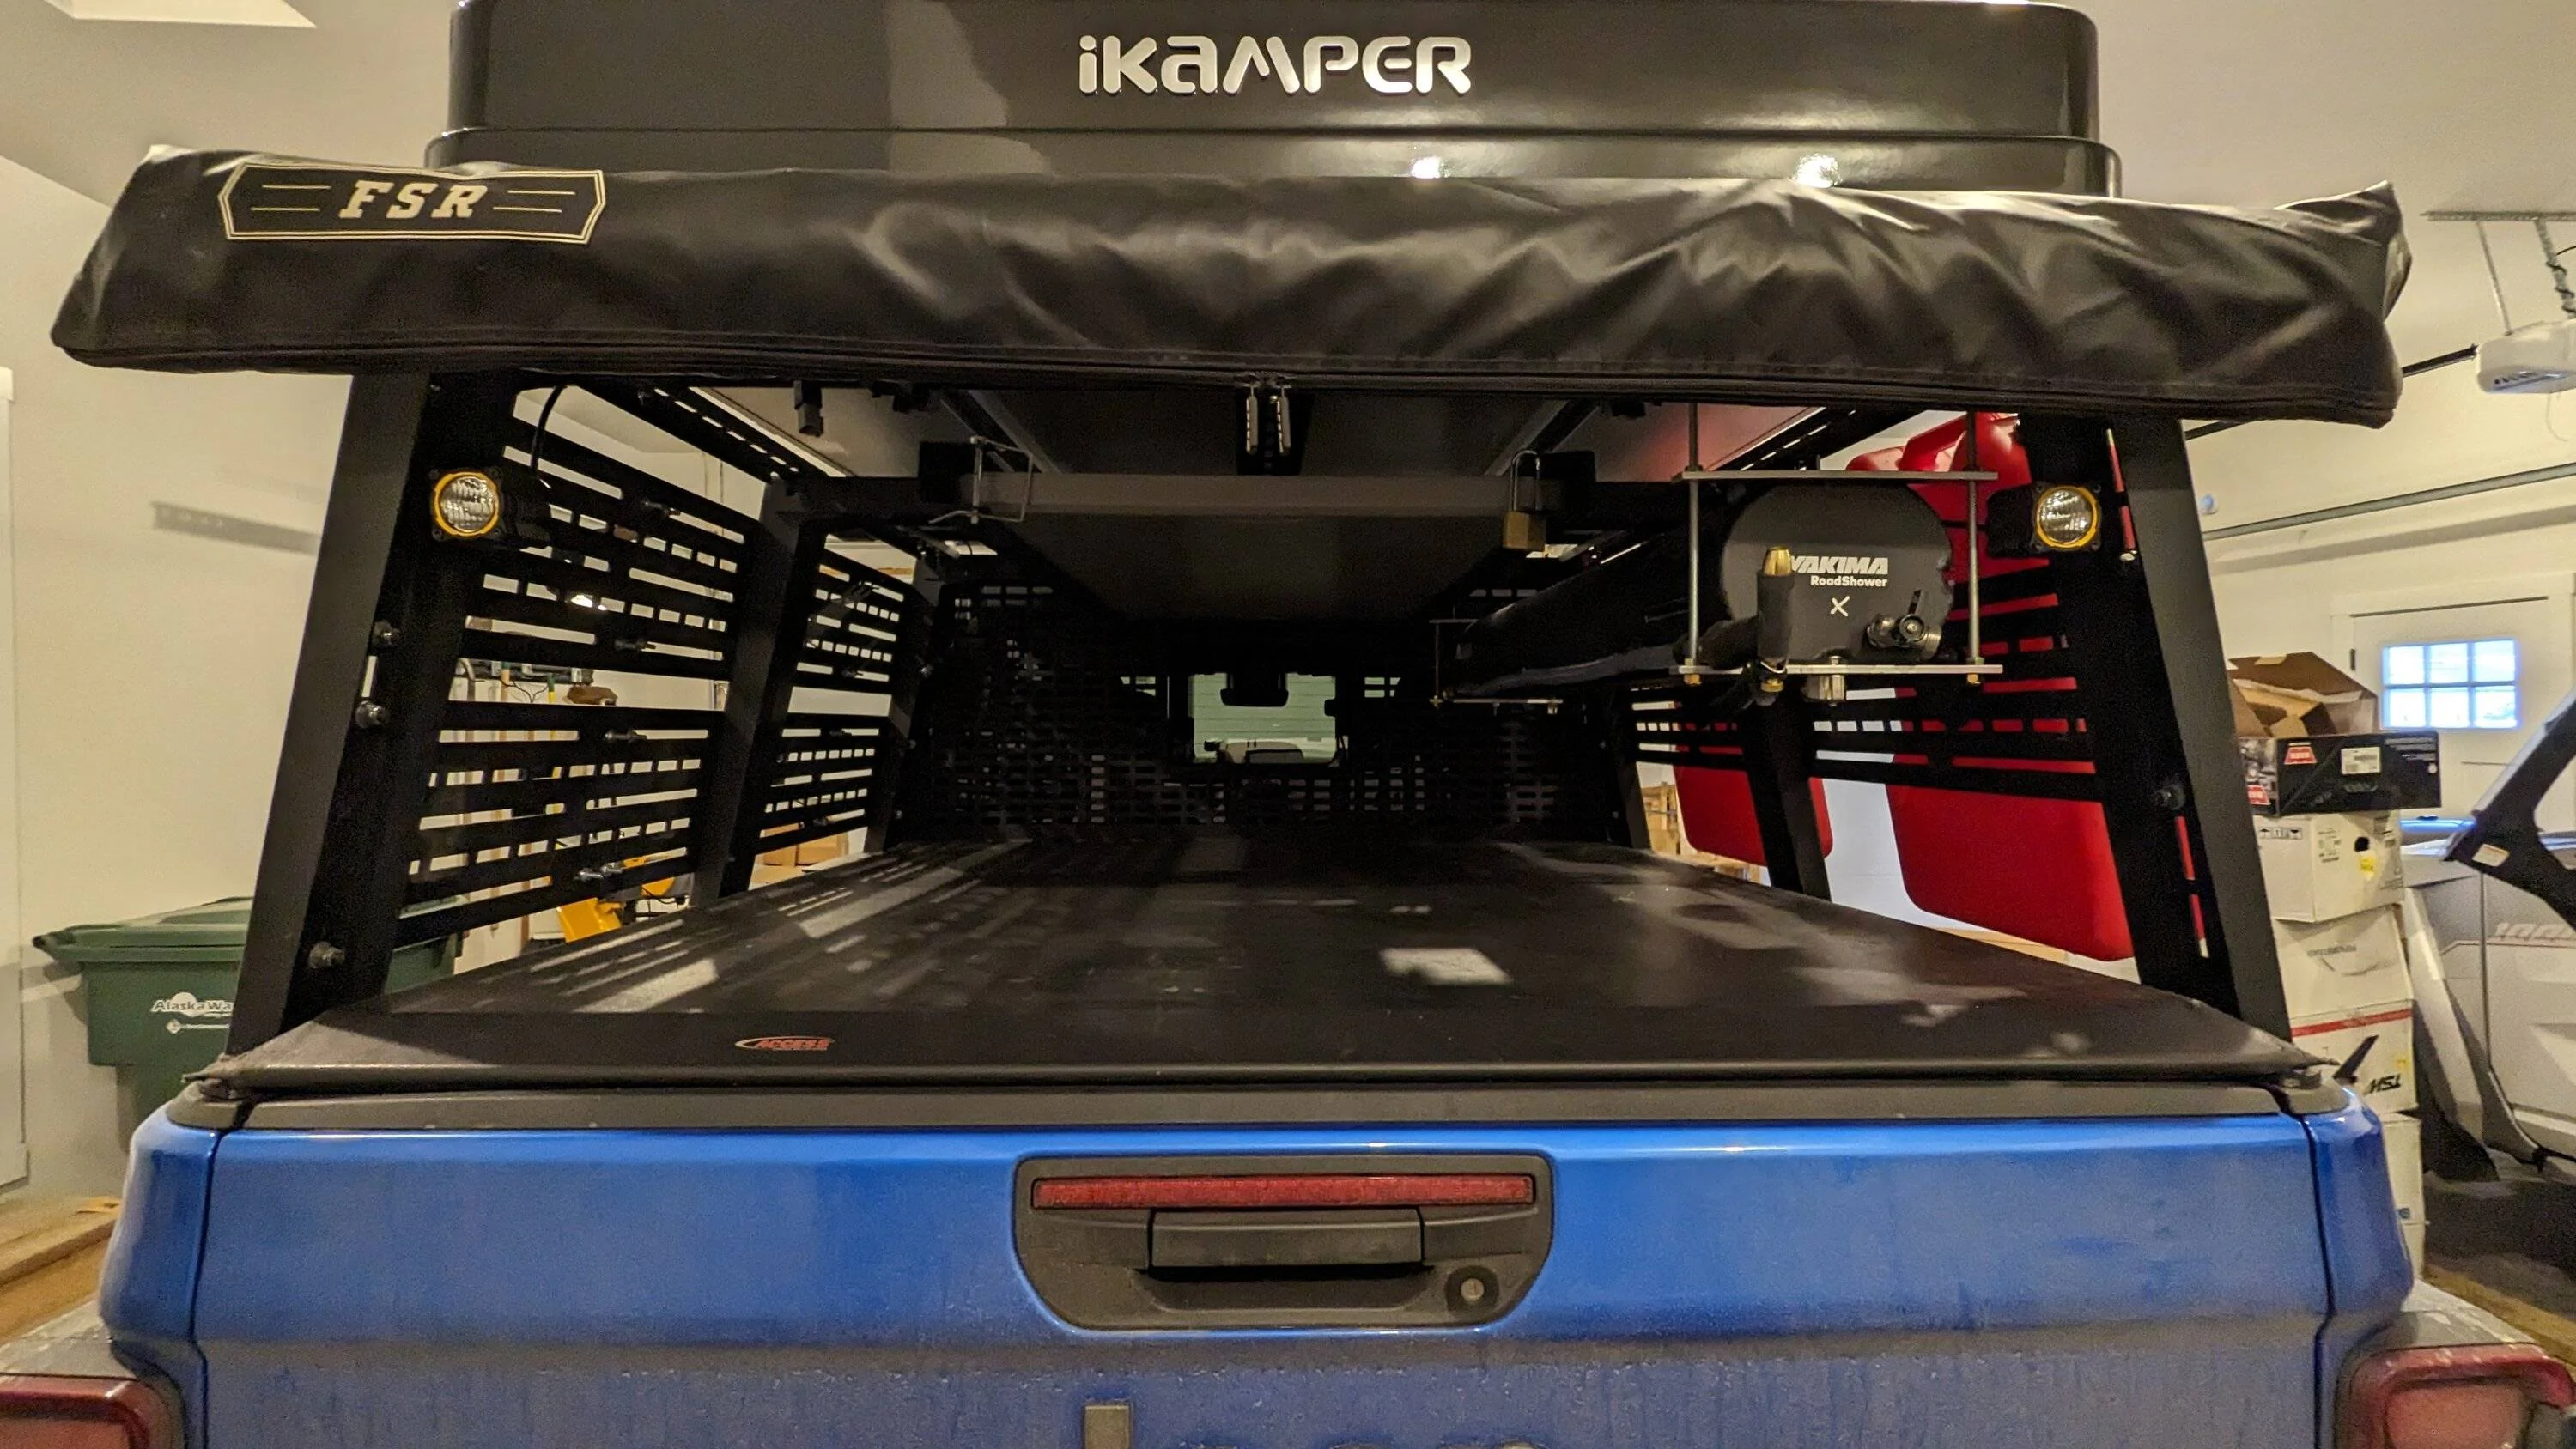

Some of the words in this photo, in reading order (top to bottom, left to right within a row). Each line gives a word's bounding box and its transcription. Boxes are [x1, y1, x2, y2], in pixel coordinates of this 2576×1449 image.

[338, 179, 489, 219] FSR
[1790, 555, 1889, 575] YAKIMA
[1810, 575, 1888, 587] RoadShower
[151, 1000, 205, 1012] Alaska
